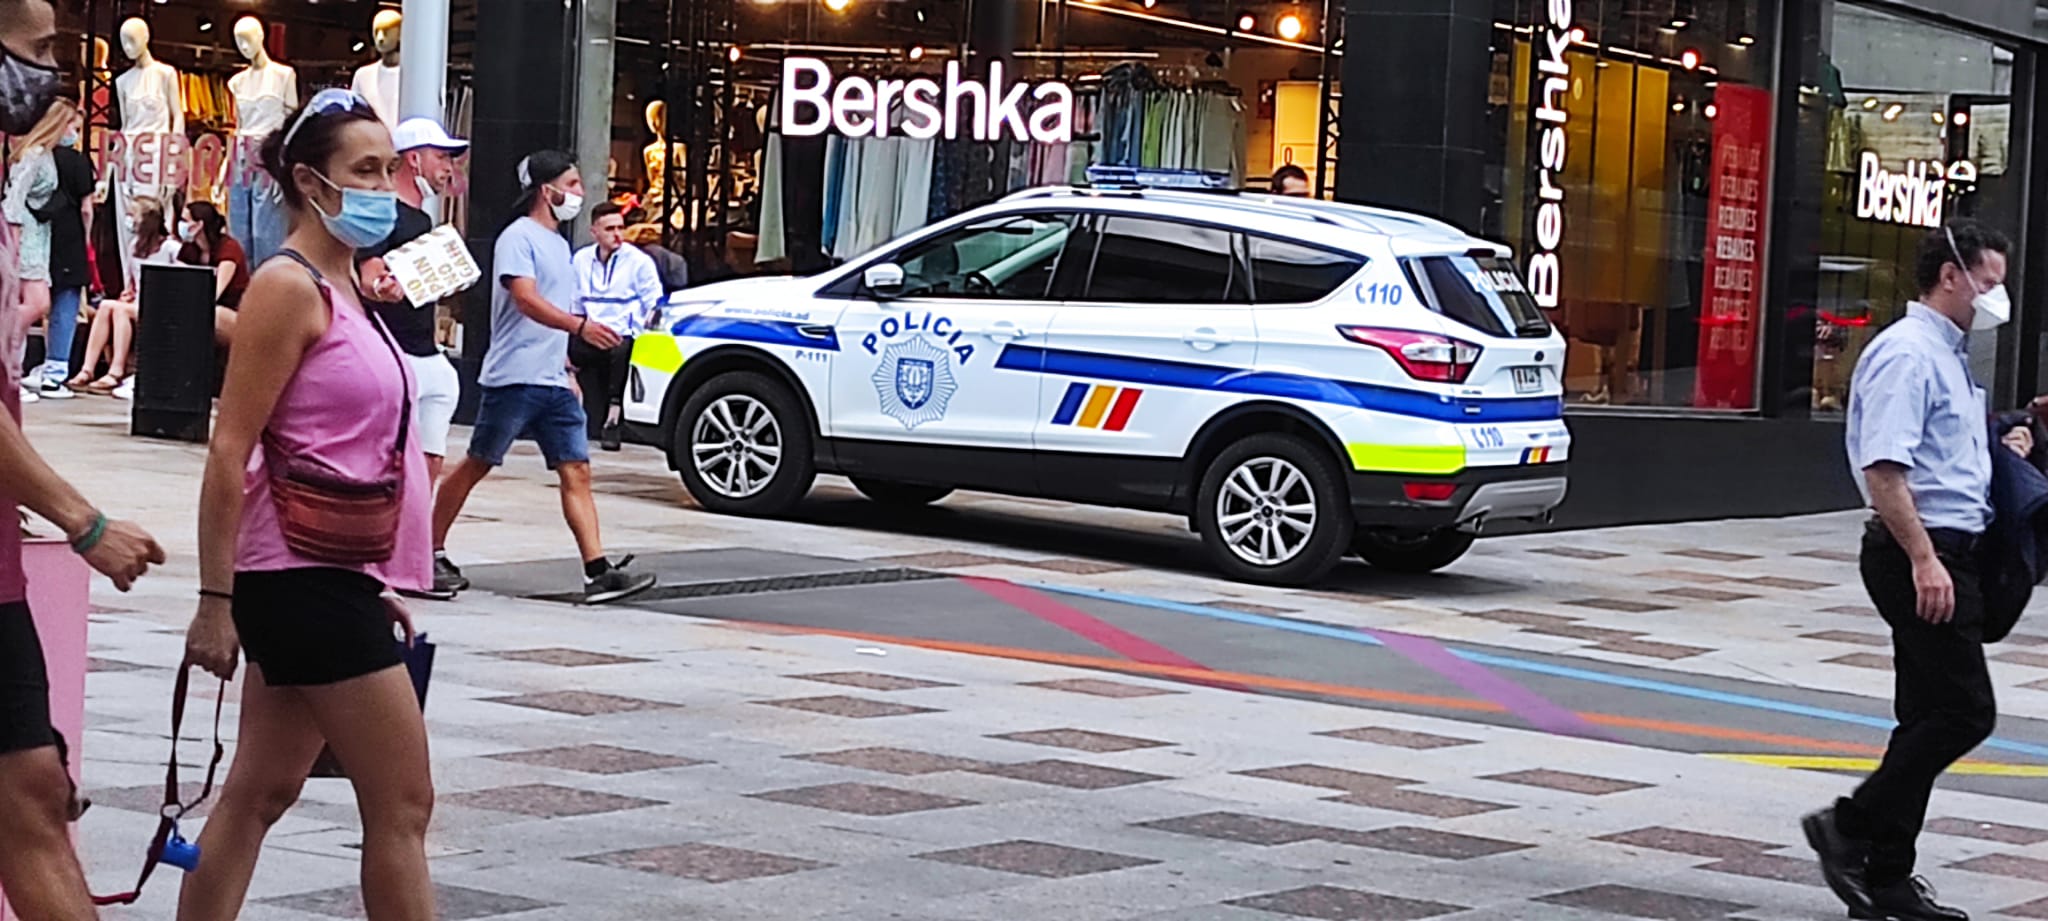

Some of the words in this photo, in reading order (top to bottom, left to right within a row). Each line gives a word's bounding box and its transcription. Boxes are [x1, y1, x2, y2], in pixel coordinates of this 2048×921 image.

[781, 57, 1073, 143] Bershka
[1857, 151, 1945, 228] Bershka
[1367, 283, 1402, 305] 110
[795, 350, 828, 363] P-111
[861, 311, 975, 366] POLICIA
[1480, 427, 1504, 447] 110
